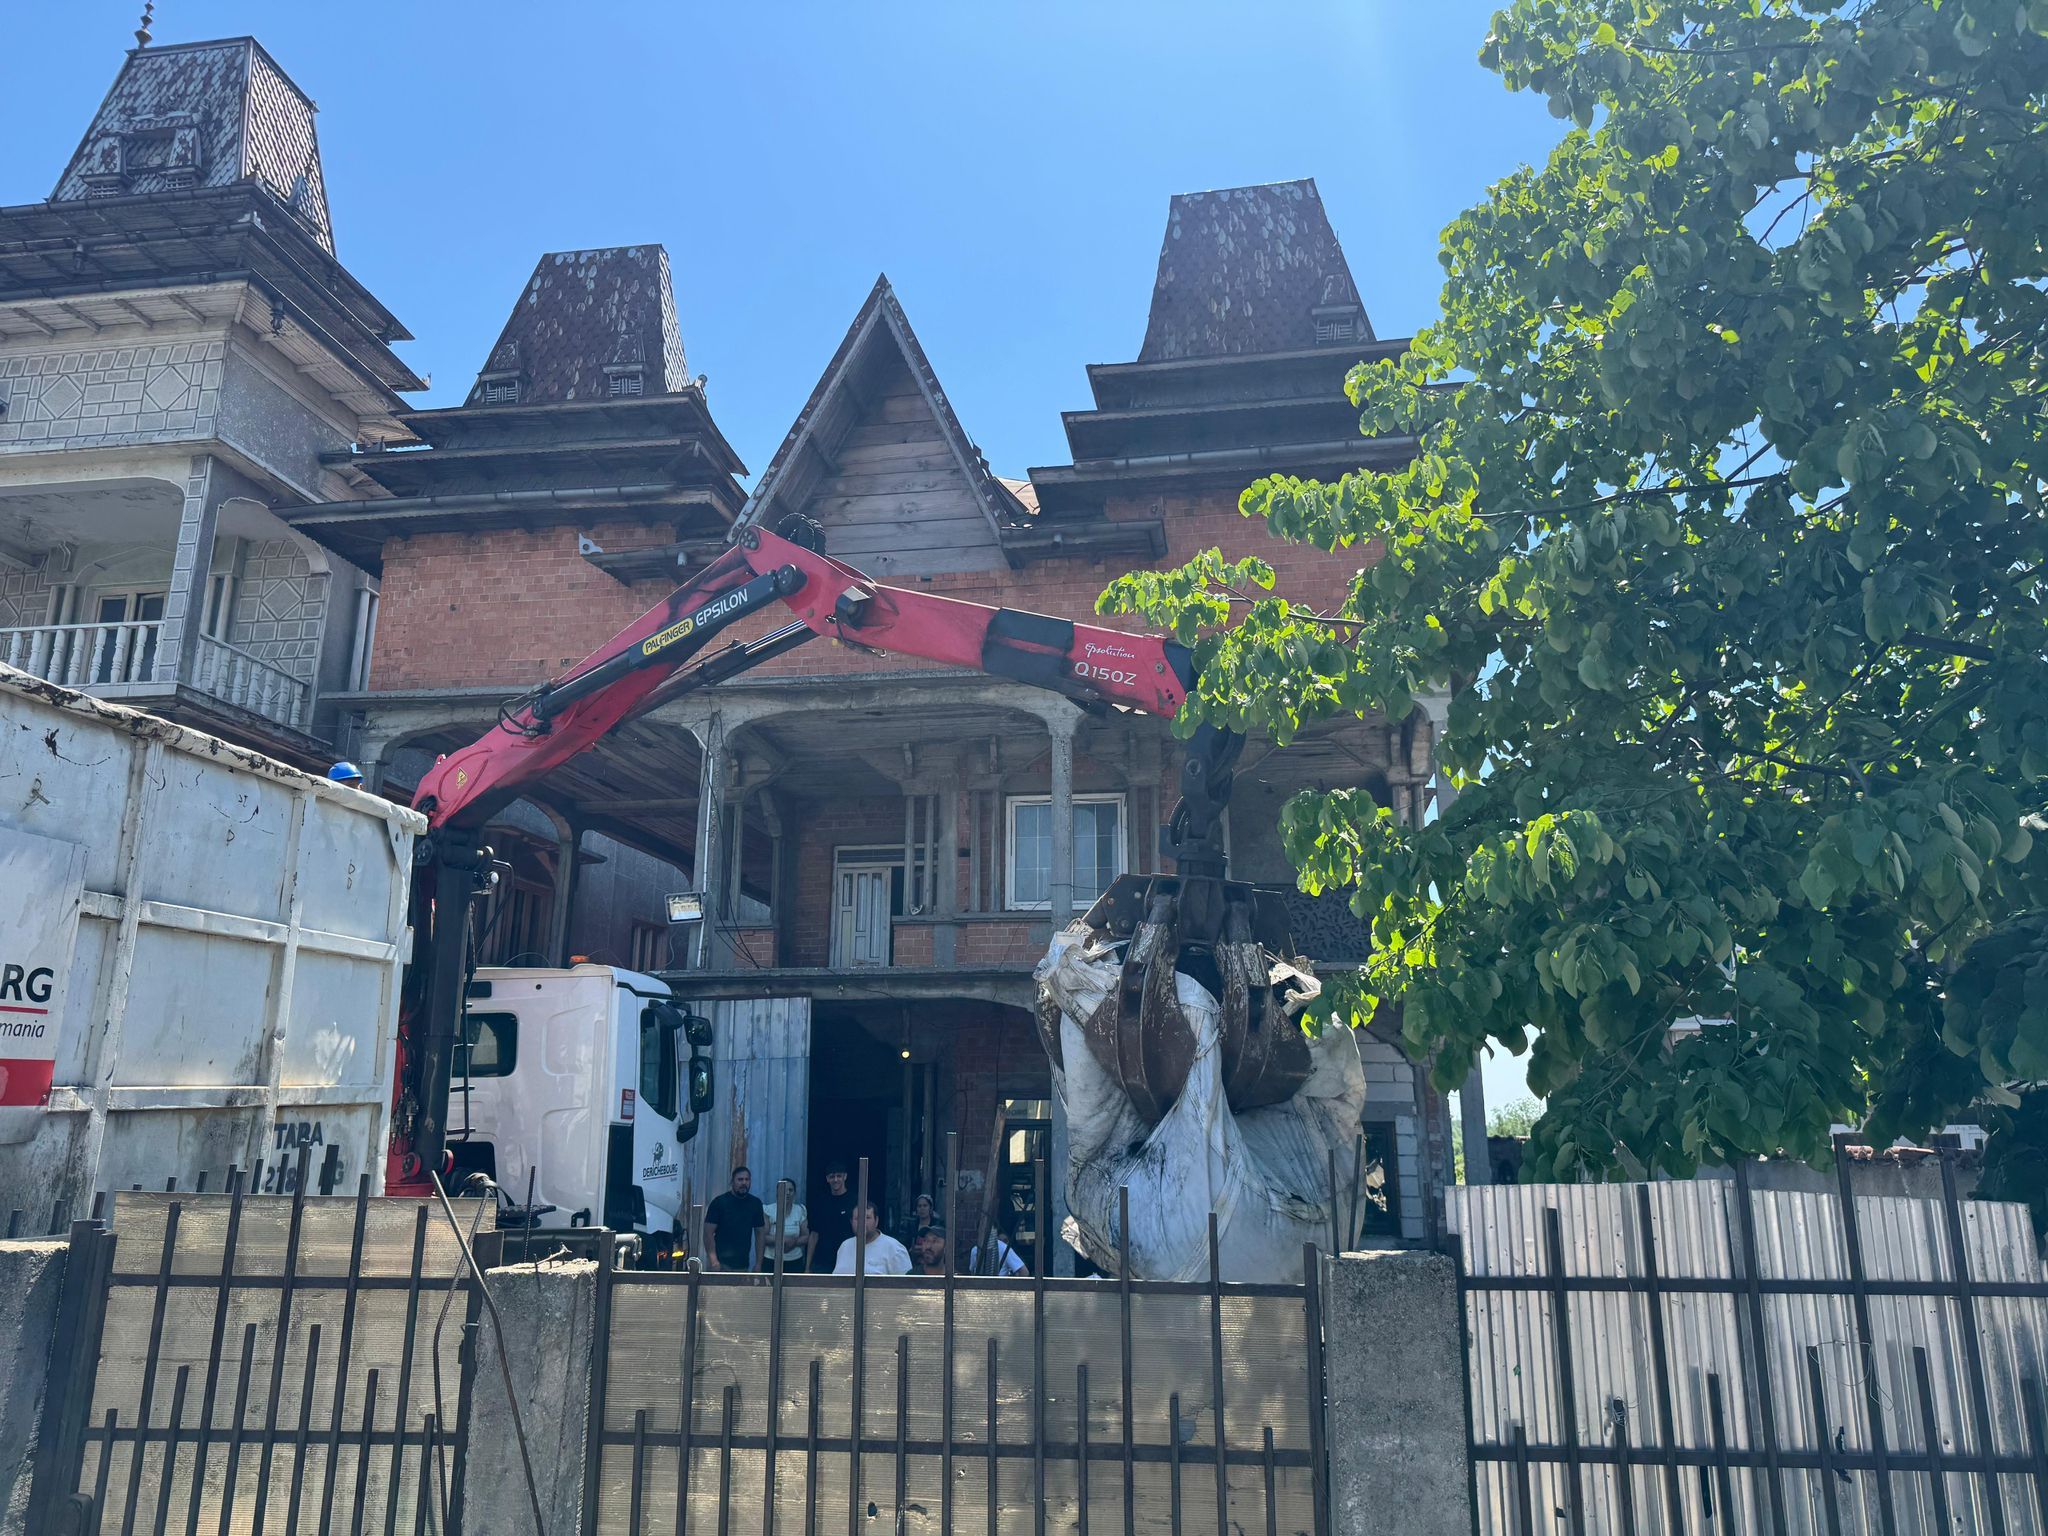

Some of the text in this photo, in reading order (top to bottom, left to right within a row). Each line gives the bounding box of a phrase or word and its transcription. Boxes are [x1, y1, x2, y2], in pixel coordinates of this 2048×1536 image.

[645, 588, 748, 653] PALFINGER EPSILON
[1085, 642, 1136, 660] Epsolution
[1074, 661, 1137, 686] Q150Z
[643, 1163, 679, 1178] DERICHEBOURG
